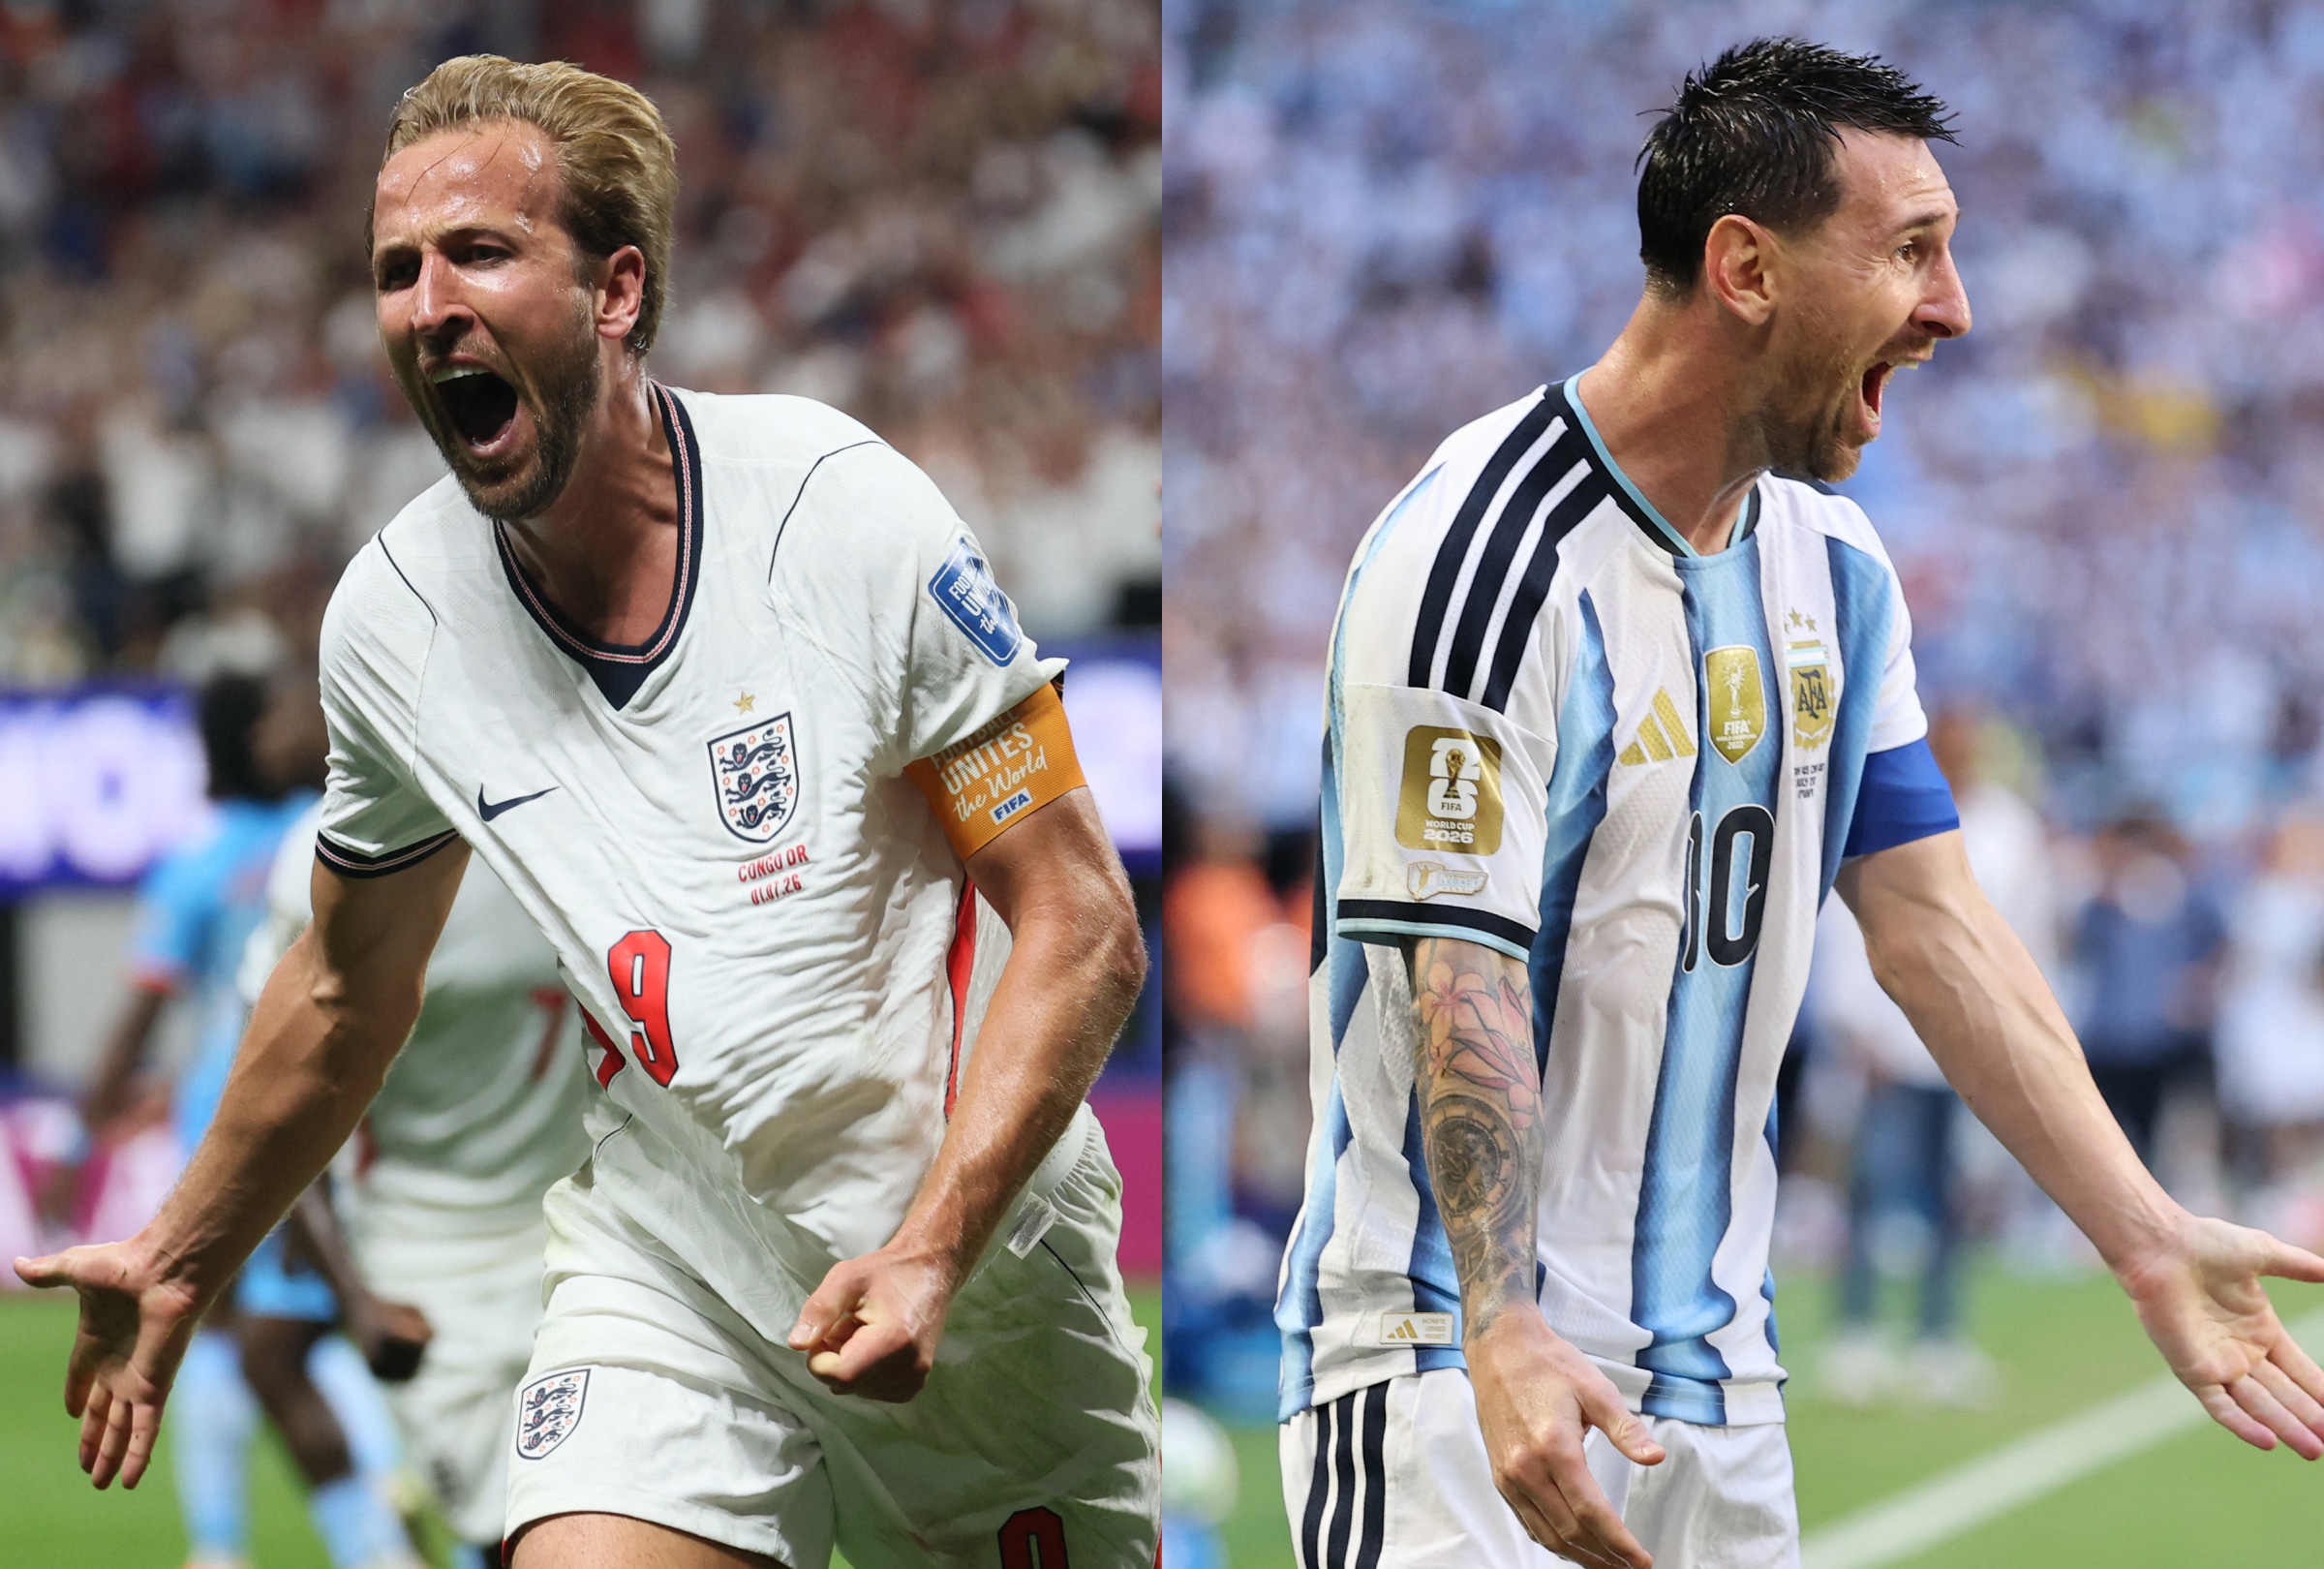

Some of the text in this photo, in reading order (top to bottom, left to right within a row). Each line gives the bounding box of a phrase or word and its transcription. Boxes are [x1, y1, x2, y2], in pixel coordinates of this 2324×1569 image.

[1724, 720, 1750, 735] FIFA
[940, 722, 1033, 795] UNITES
[953, 745, 1048, 822] the World
[994, 793, 1029, 820] FIFA
[1441, 801, 1462, 812] FIFA
[1423, 828, 1475, 845] 2026
[1424, 819, 1475, 831] WORLD CUP
[738, 852, 783, 882] CONGO
[1682, 804, 1777, 973] 10
[607, 929, 680, 1089] 9
